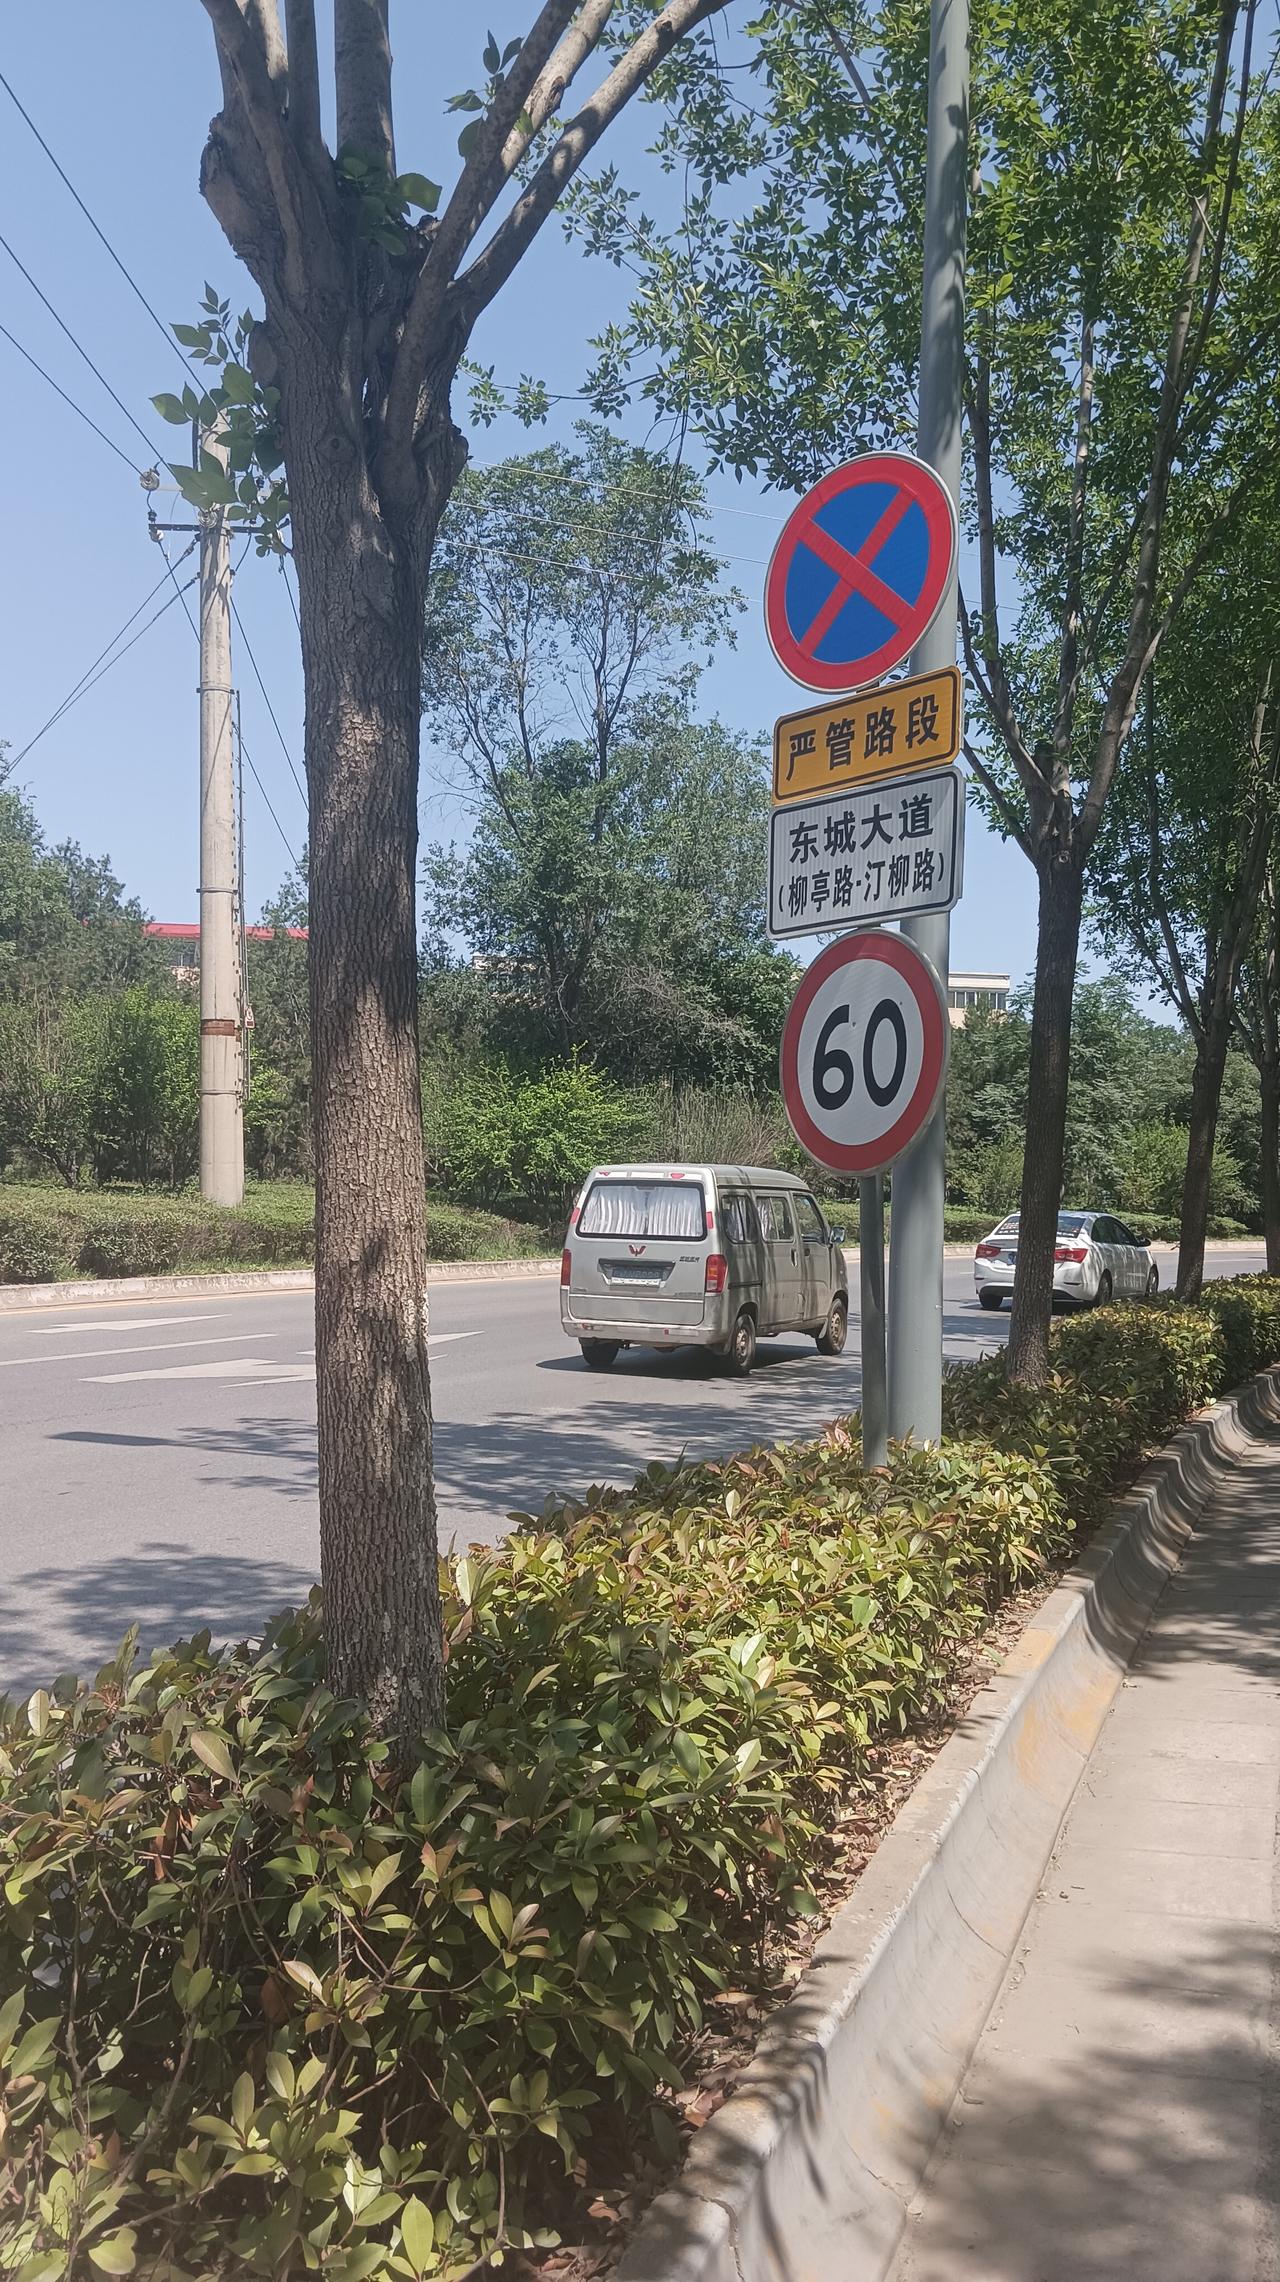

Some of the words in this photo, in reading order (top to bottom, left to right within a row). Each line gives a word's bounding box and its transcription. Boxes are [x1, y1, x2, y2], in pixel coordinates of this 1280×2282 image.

[786, 694, 939, 781] 严管路段
[789, 793, 934, 864] 东城大道
[812, 998, 907, 1111] 60
